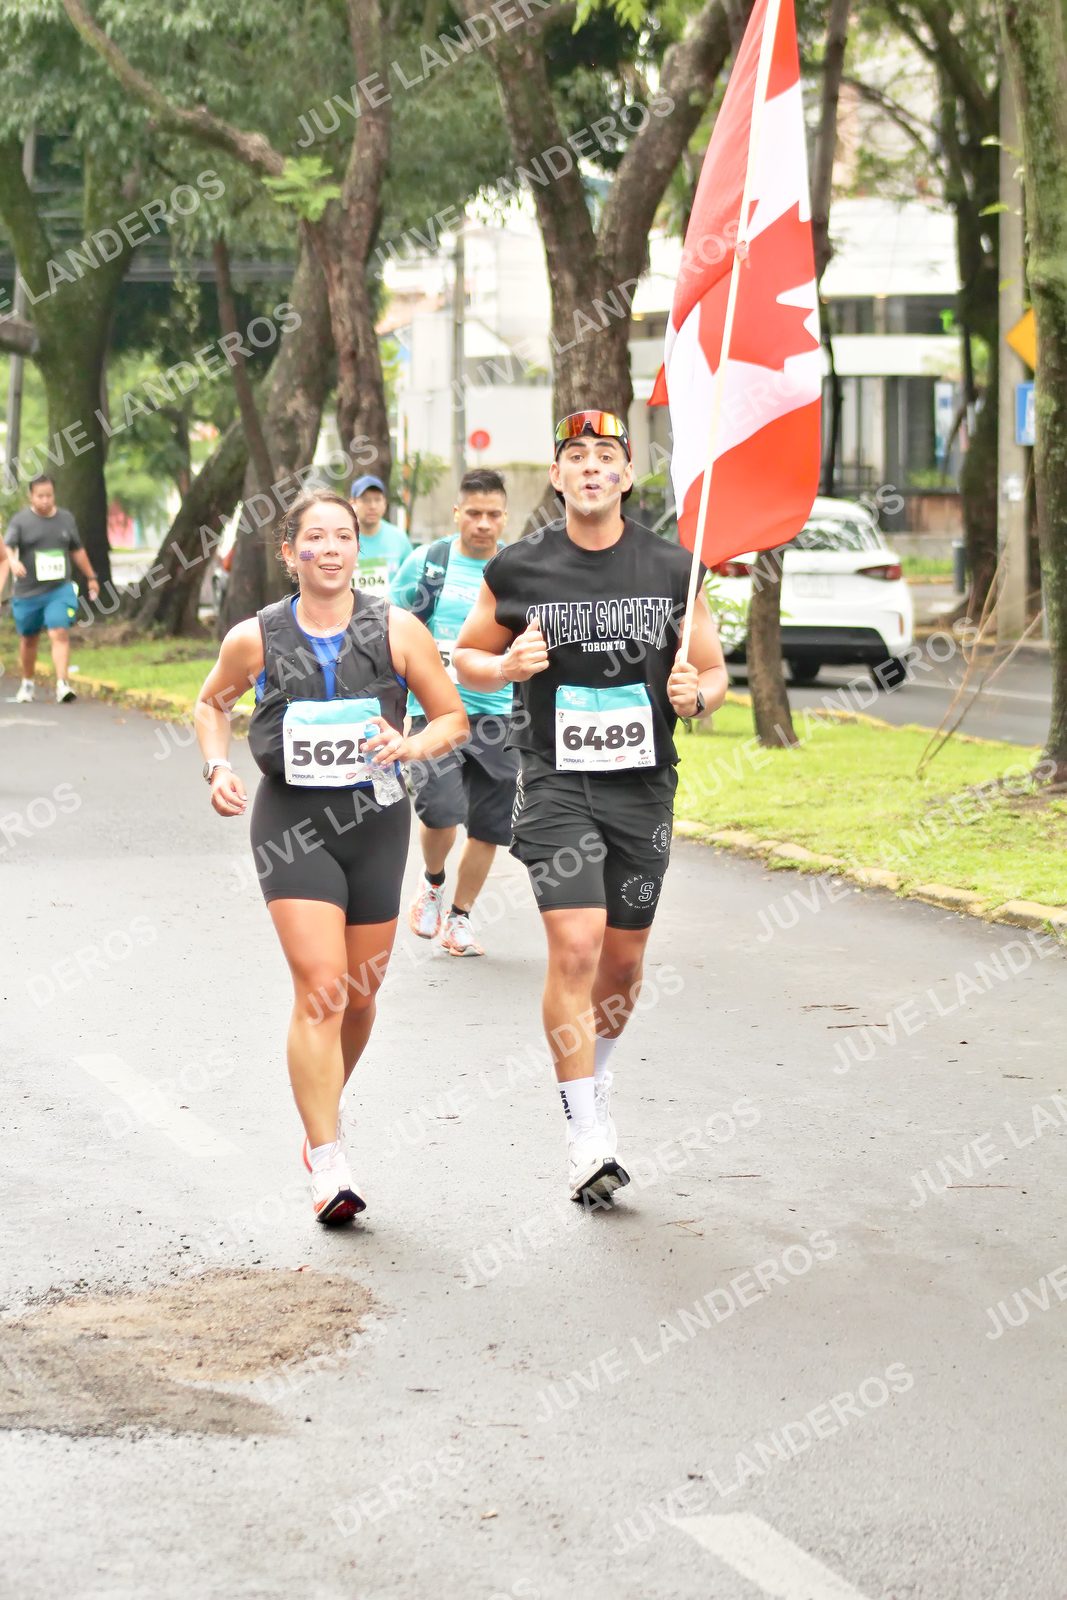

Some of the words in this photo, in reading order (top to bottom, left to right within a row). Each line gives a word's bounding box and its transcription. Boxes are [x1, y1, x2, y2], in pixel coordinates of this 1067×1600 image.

[596, 598, 673, 650] SOCIETY
[581, 640, 626, 652] TORONTO
[562, 722, 646, 751] 6489
[638, 881, 654, 902] S
